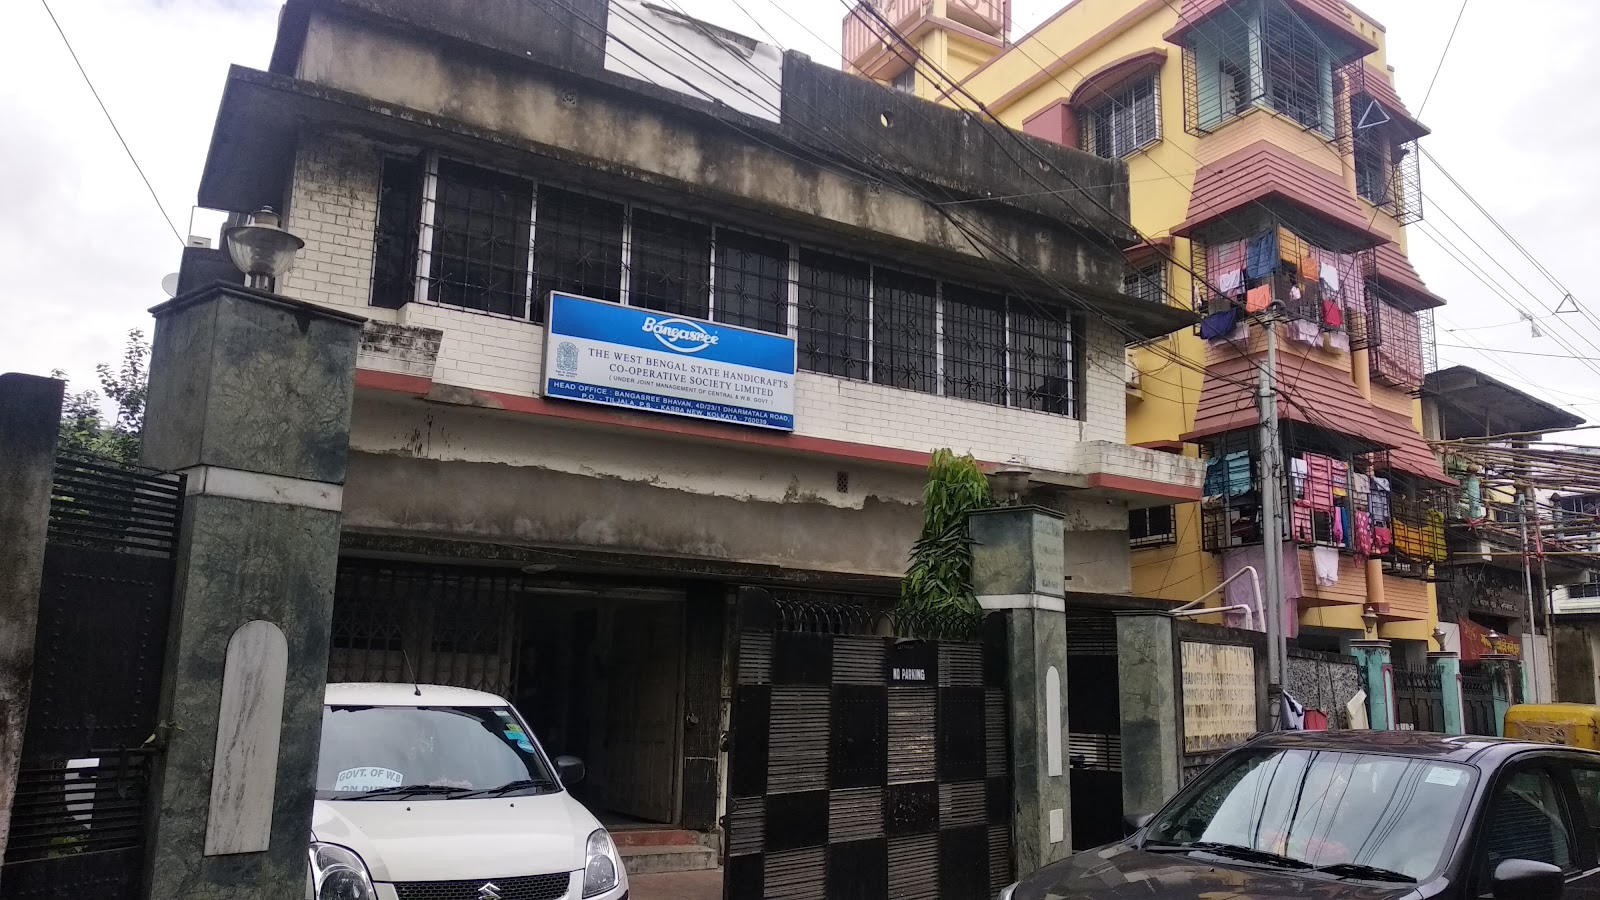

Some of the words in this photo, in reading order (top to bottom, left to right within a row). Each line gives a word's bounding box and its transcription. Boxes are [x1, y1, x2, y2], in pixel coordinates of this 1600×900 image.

[588, 347, 610, 359] THE
[613, 351, 643, 364] WEST
[646, 357, 687, 372] BENGAL
[690, 364, 720, 377] STATE
[723, 370, 789, 389] HANDICRAFTS
[609, 363, 687, 383] CO-OPERATIVE
[689, 376, 732, 390] SOCIETY
[734, 383, 774, 397] LIMITED
[655, 382, 697, 393] MANAGEMENT
[707, 390, 733, 399] CENTRAL
[553, 381, 576, 390] HEAD
[578, 385, 607, 395] OFFICE
[614, 390, 661, 403] BANGASREE
[695, 402, 721, 412] 4D/23/1
[723, 405, 768, 418] DHARMATALA
[660, 405, 685, 413] KASBA
[706, 411, 738, 420] KOLKATA
[893, 667, 901, 680] NO
[901, 668, 925, 680] PARKING
[339, 768, 366, 782] GOVT.
[370, 768, 384, 778] OF
